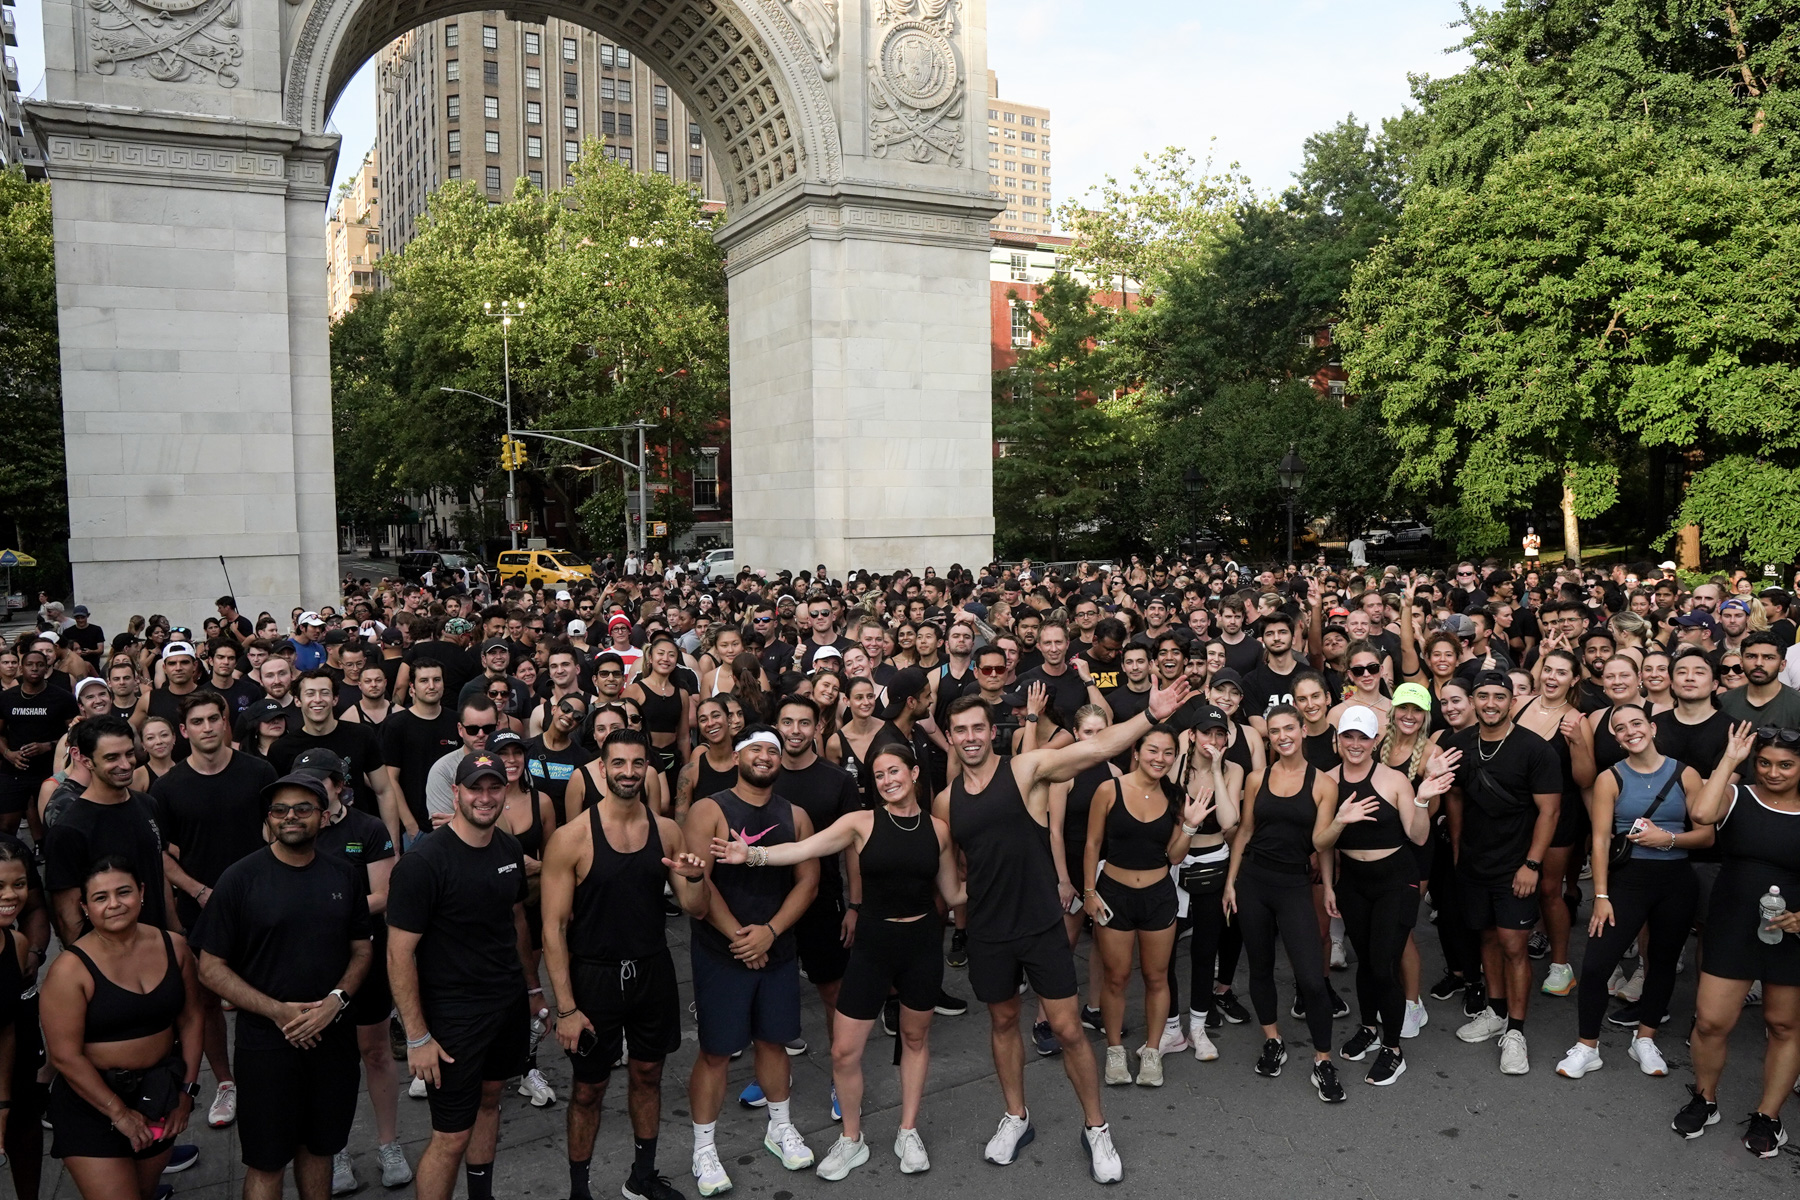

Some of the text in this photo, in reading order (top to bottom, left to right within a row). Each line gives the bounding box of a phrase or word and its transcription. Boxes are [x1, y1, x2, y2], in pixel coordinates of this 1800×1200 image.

[1090, 671, 1119, 688] CAT
[11, 707, 48, 716] GYMSHARK
[1209, 710, 1222, 719] alo
